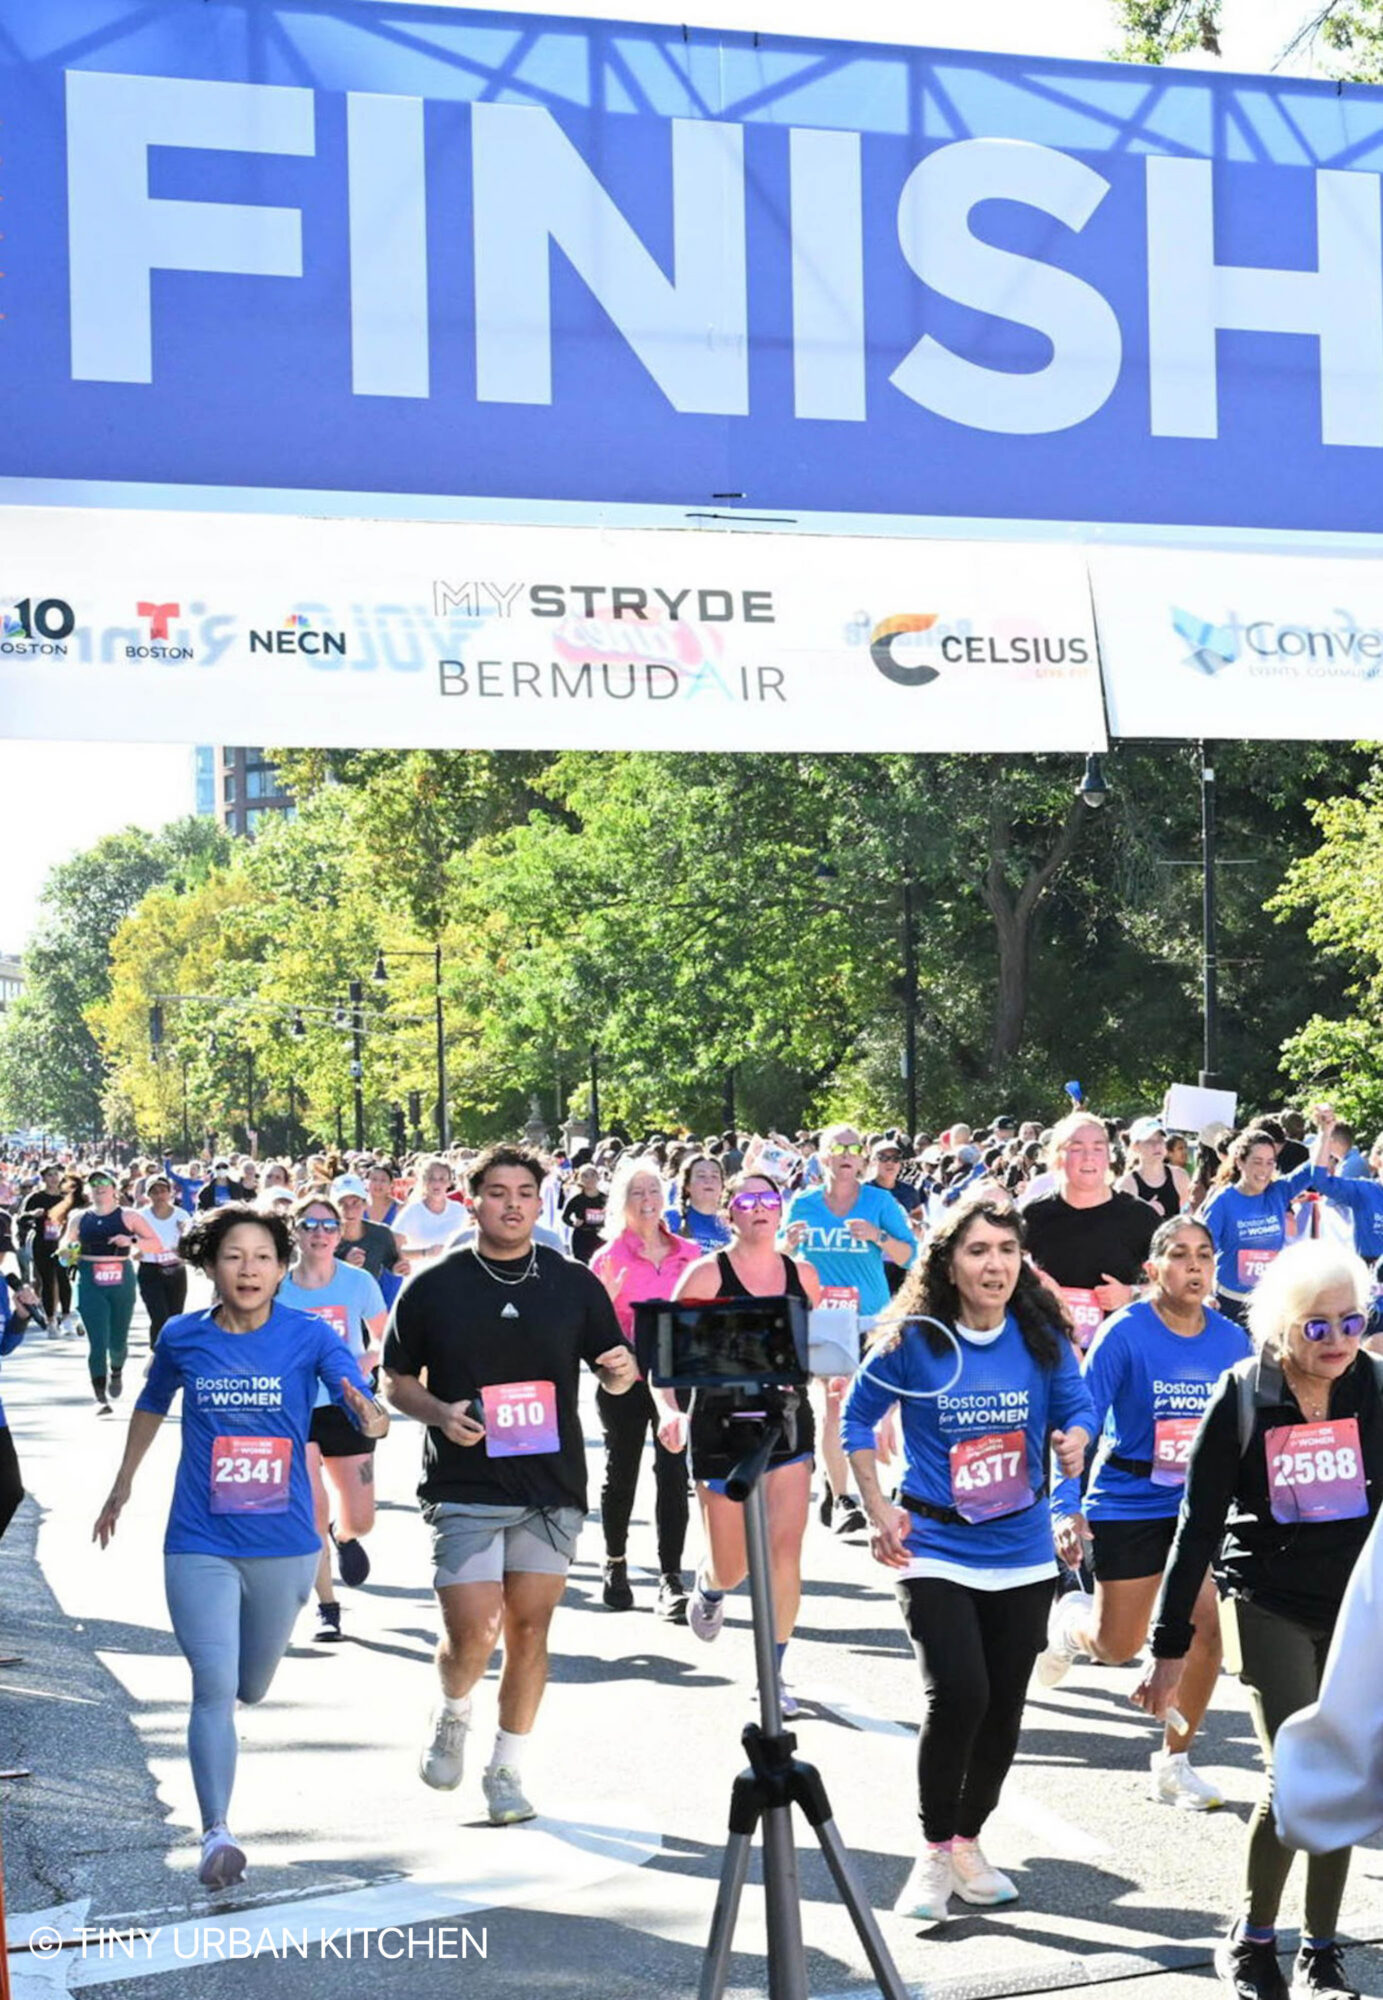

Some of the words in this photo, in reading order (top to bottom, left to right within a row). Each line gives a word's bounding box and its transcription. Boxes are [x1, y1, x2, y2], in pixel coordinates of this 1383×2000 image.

[65, 69, 1383, 448] FINISH
[14, 598, 75, 640] 10
[0, 641, 68, 656] OSTON
[249, 630, 347, 655] NECN
[941, 636, 1089, 664] CELSIUS
[1245, 621, 1383, 658] Conve
[126, 645, 194, 660] BOSTON
[196, 1377, 250, 1391] Boston
[251, 1376, 282, 1390] 10K
[1153, 1380, 1205, 1395] Boston
[211, 1391, 283, 1406] WOMEN
[937, 1394, 998, 1410] Boston
[998, 1390, 1029, 1407] 10K
[1169, 1396, 1210, 1410] WOM
[497, 1401, 545, 1428] 810
[956, 1407, 1029, 1425] WOMEN
[1159, 1440, 1192, 1463] 52
[215, 1457, 283, 1484] 2341
[955, 1451, 1021, 1490] 4377
[1273, 1447, 1358, 1487] 2588
